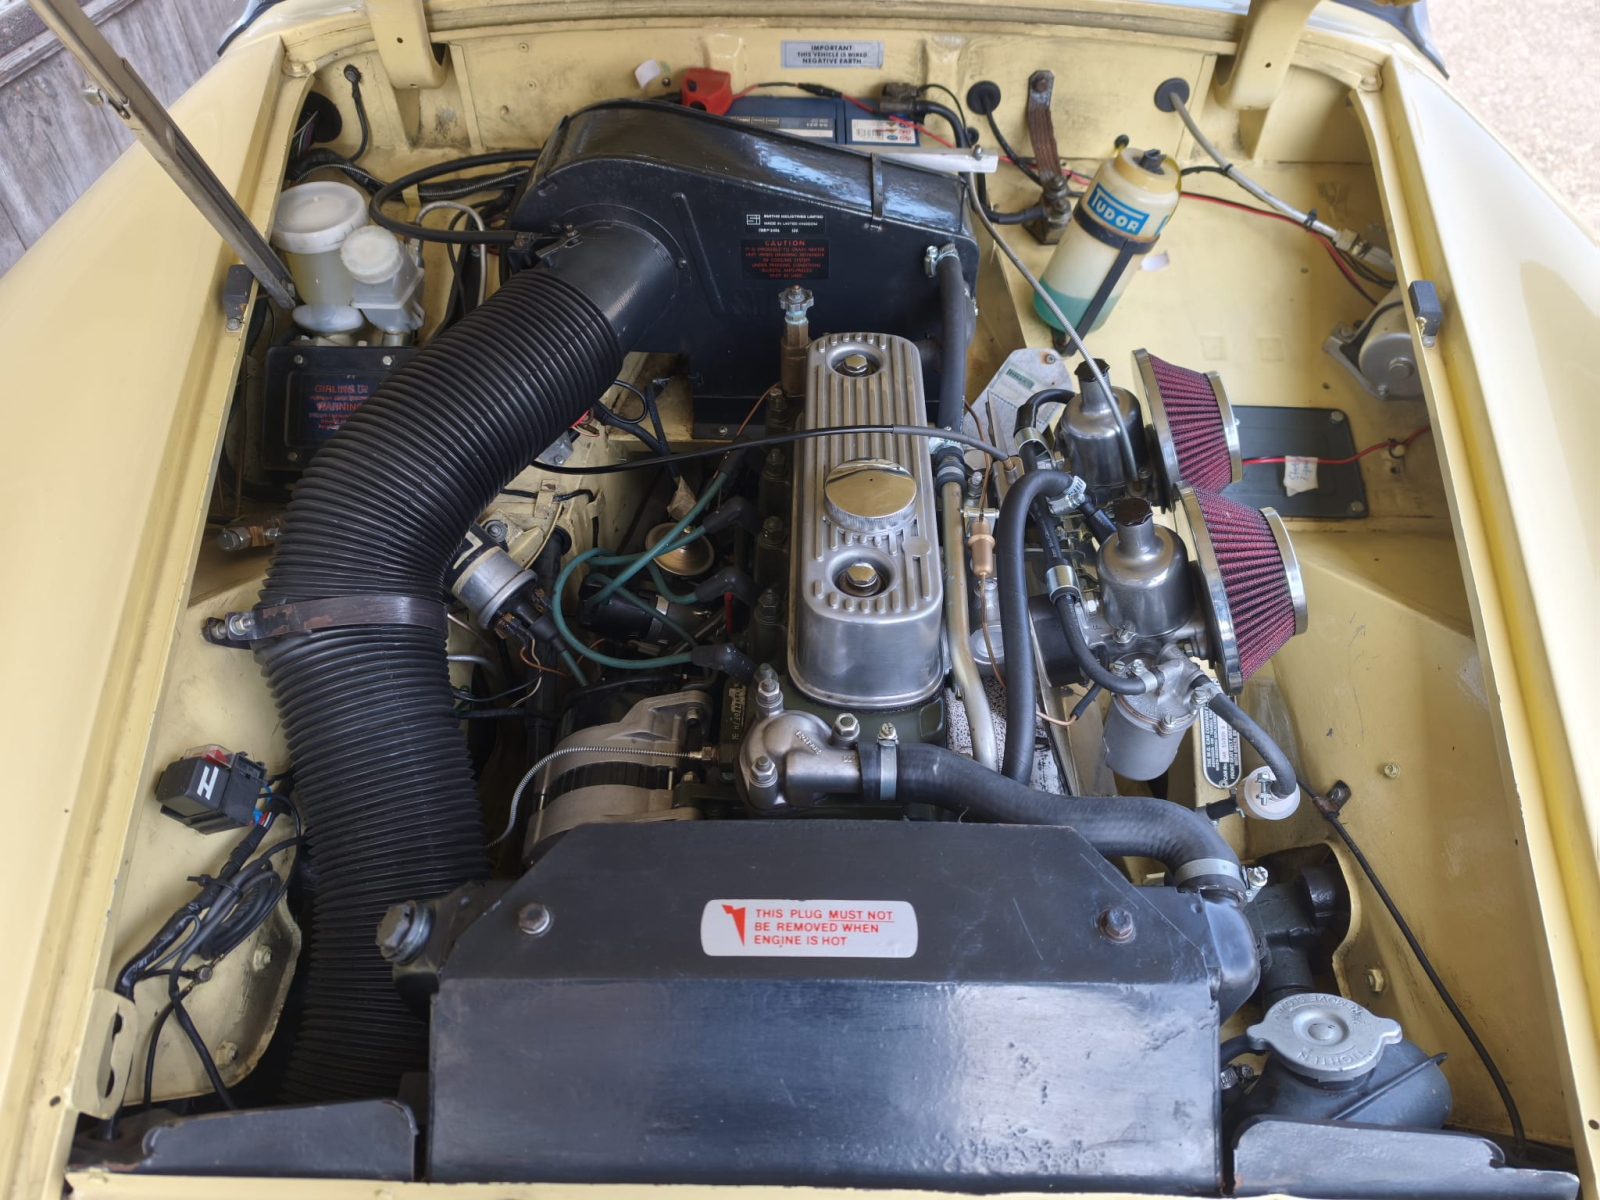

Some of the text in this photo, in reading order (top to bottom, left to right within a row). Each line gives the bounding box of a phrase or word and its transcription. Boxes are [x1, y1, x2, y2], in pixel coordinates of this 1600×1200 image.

[1091, 187, 1144, 232] TUDOR
[314, 384, 356, 393] GIRLING
[755, 909, 894, 920] THIS PLUG MUST NOT
[754, 922, 879, 933] BE REMOVED WHEN
[754, 935, 847, 946] ENGINE IS HOT
